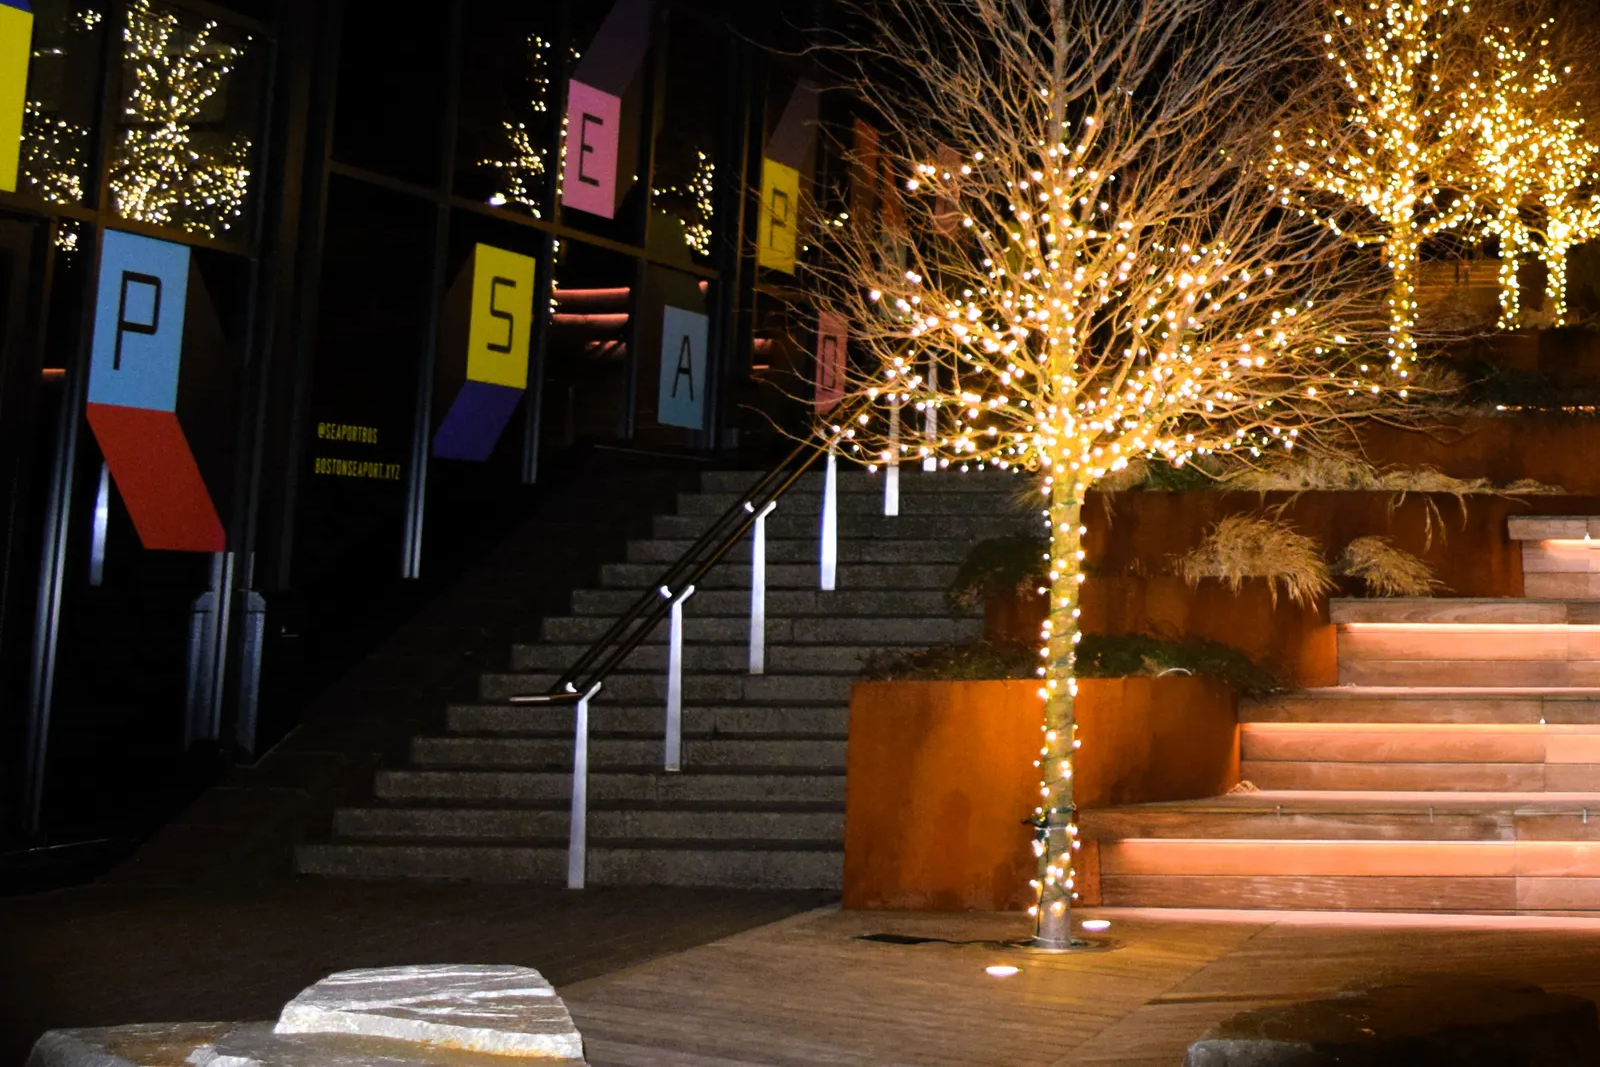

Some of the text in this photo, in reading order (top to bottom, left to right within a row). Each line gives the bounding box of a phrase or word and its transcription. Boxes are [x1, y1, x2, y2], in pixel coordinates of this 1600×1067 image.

[579, 112, 604, 187] E
[113, 270, 162, 371] P
[487, 277, 517, 355] S
[671, 334, 695, 402] A
[316, 421, 379, 445] @SEAPORTBOS
[314, 457, 402, 481] BOSTONSEAPORT.XYZ
